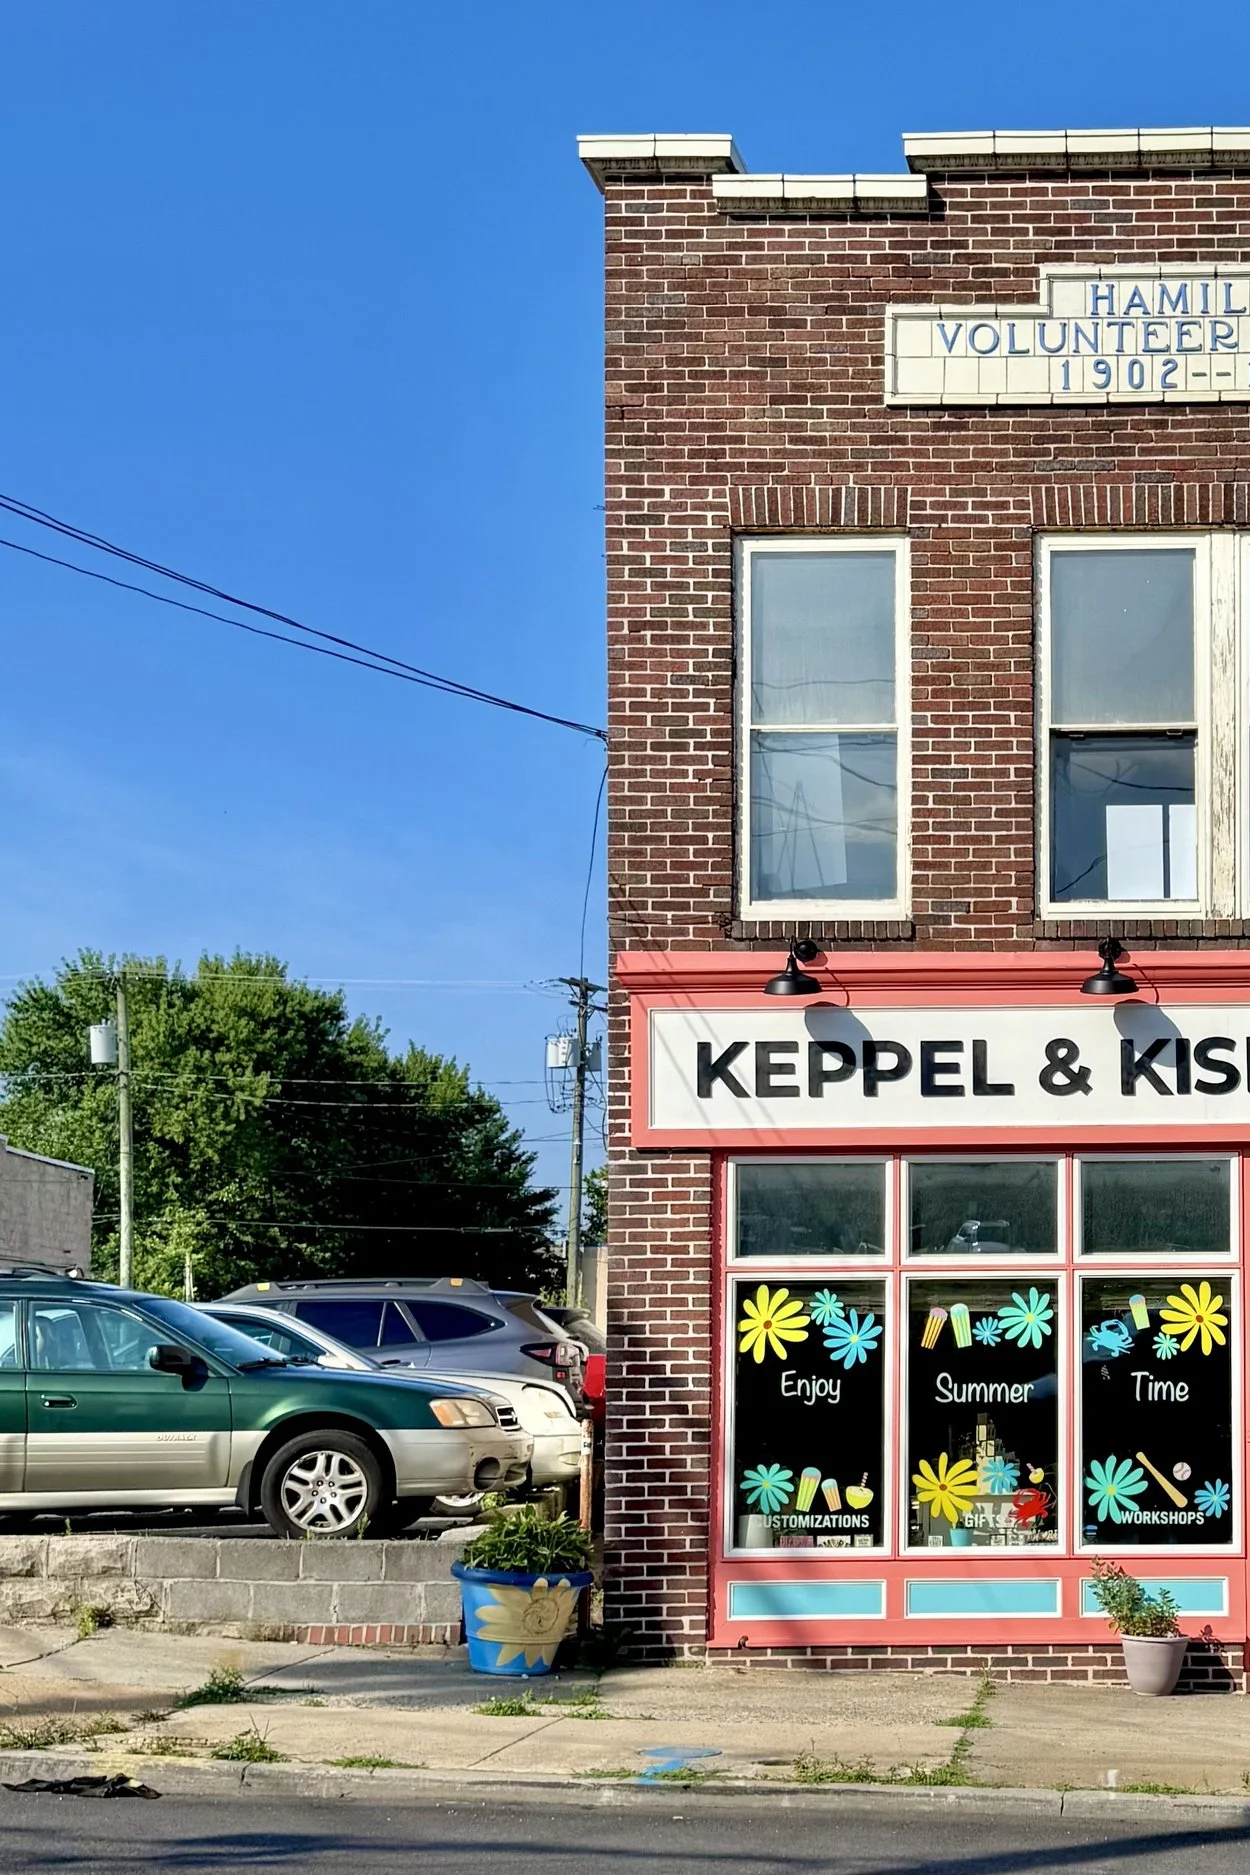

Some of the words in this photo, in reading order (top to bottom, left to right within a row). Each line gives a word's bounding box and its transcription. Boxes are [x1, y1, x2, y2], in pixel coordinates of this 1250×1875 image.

[935, 317, 1239, 355] VOLUNTEER
[696, 1039, 1016, 1100] KEPPEL
[1038, 1037, 1093, 1098] &
[780, 1370, 842, 1406] Enjoy
[934, 1371, 1034, 1404] Summer
[1130, 1371, 1189, 1402] Time
[1120, 1510, 1205, 1525] WORKSHOPS
